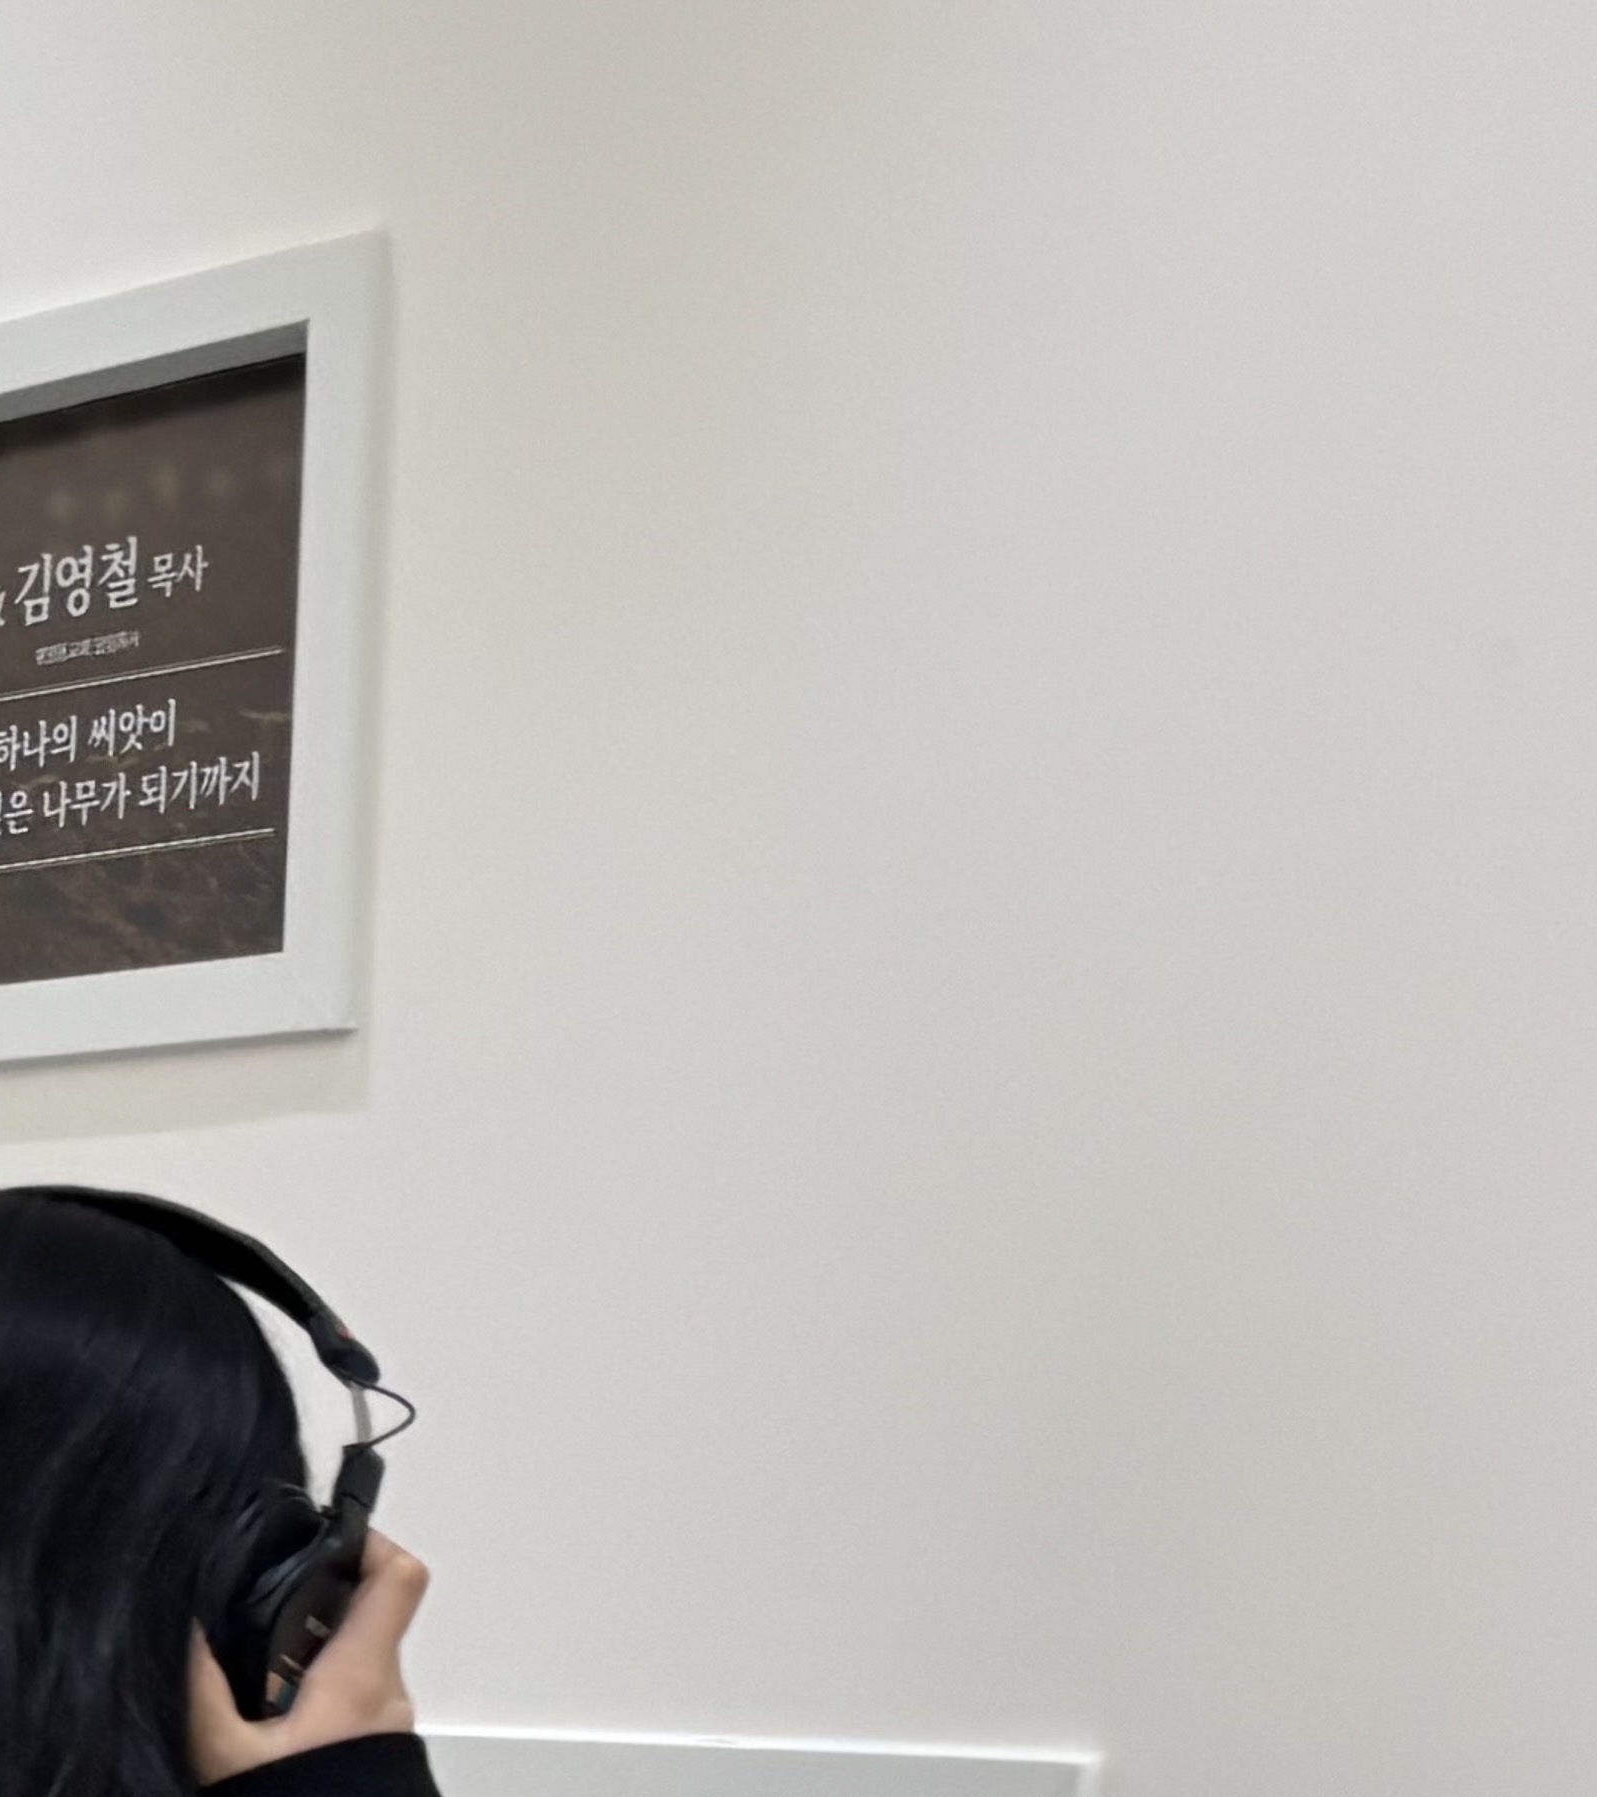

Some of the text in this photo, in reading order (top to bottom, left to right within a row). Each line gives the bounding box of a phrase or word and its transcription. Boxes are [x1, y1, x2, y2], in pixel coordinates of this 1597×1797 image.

[14, 536, 138, 626] 김영철
[148, 545, 209, 597] 목사
[88, 698, 176, 756] 씨앗이
[43, 772, 132, 828] 나무가
[139, 751, 260, 814] 되기까지
